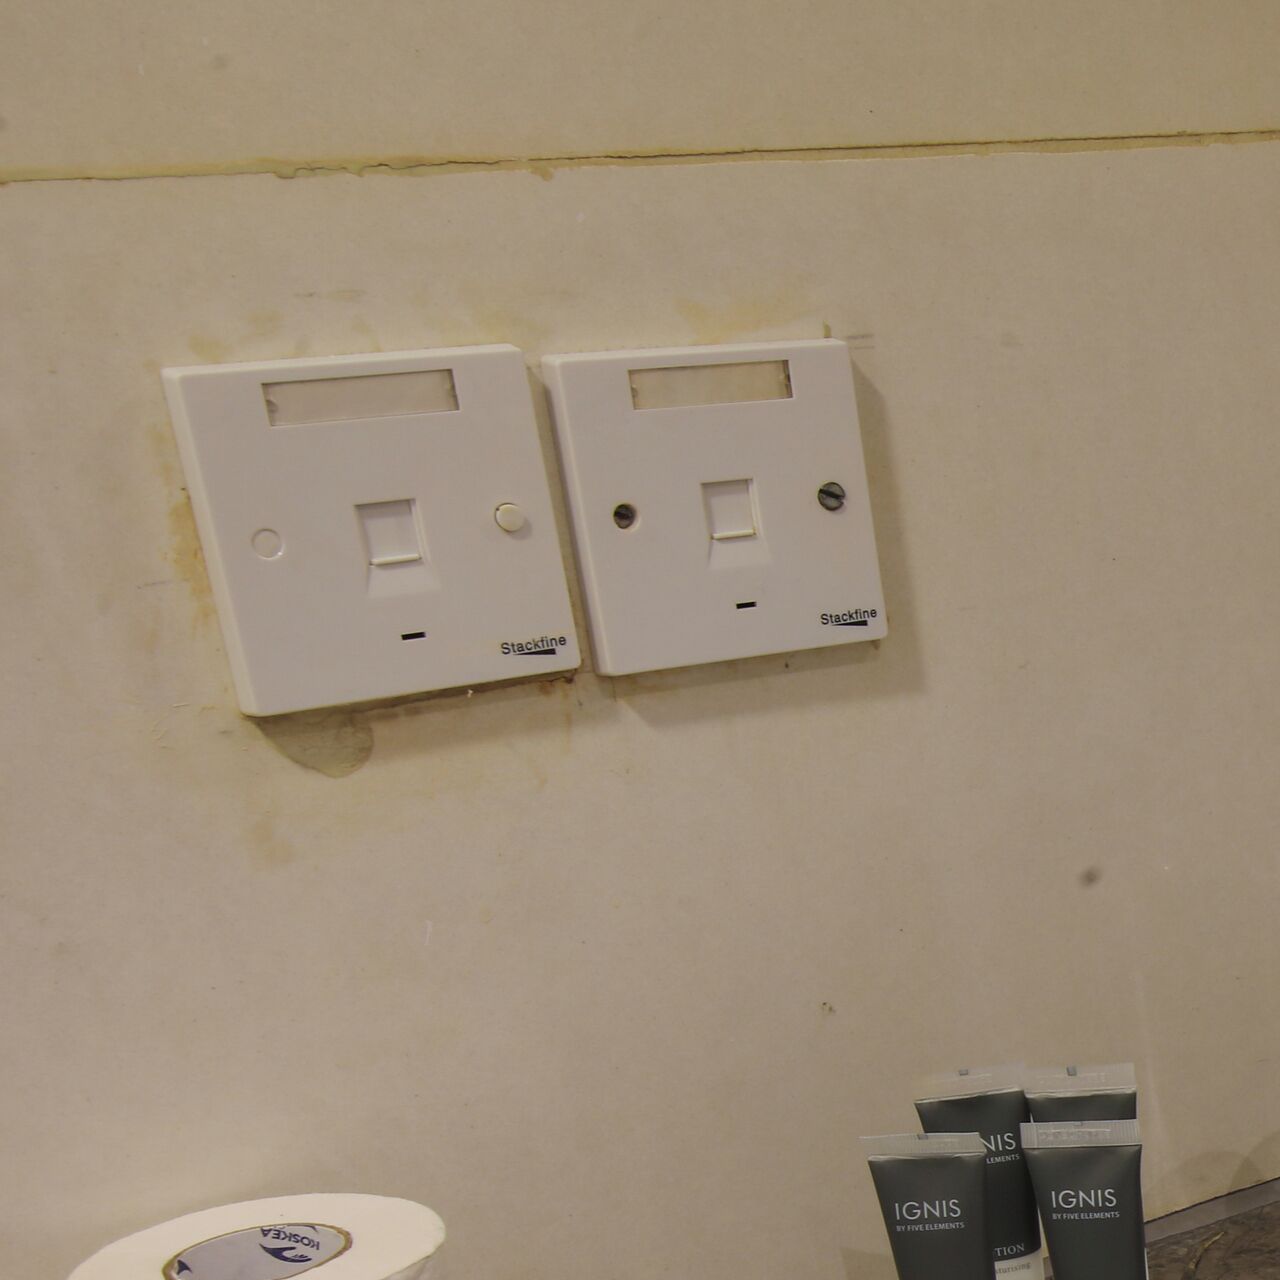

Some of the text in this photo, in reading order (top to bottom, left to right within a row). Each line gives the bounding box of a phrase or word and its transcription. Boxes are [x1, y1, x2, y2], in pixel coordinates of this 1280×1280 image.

[821, 609, 877, 625] Stackfine
[501, 636, 566, 655] Stackfine
[1051, 1188, 1117, 1209] IGNIS
[895, 1199, 961, 1220] IGNIS
[1063, 1212, 1080, 1220] FIVE
[1080, 1211, 1120, 1219] ELEMENTS
[907, 1223, 925, 1232] FIVE
[925, 1221, 965, 1231] ELEMENTS
[261, 1227, 320, 1250] KOSKEA
